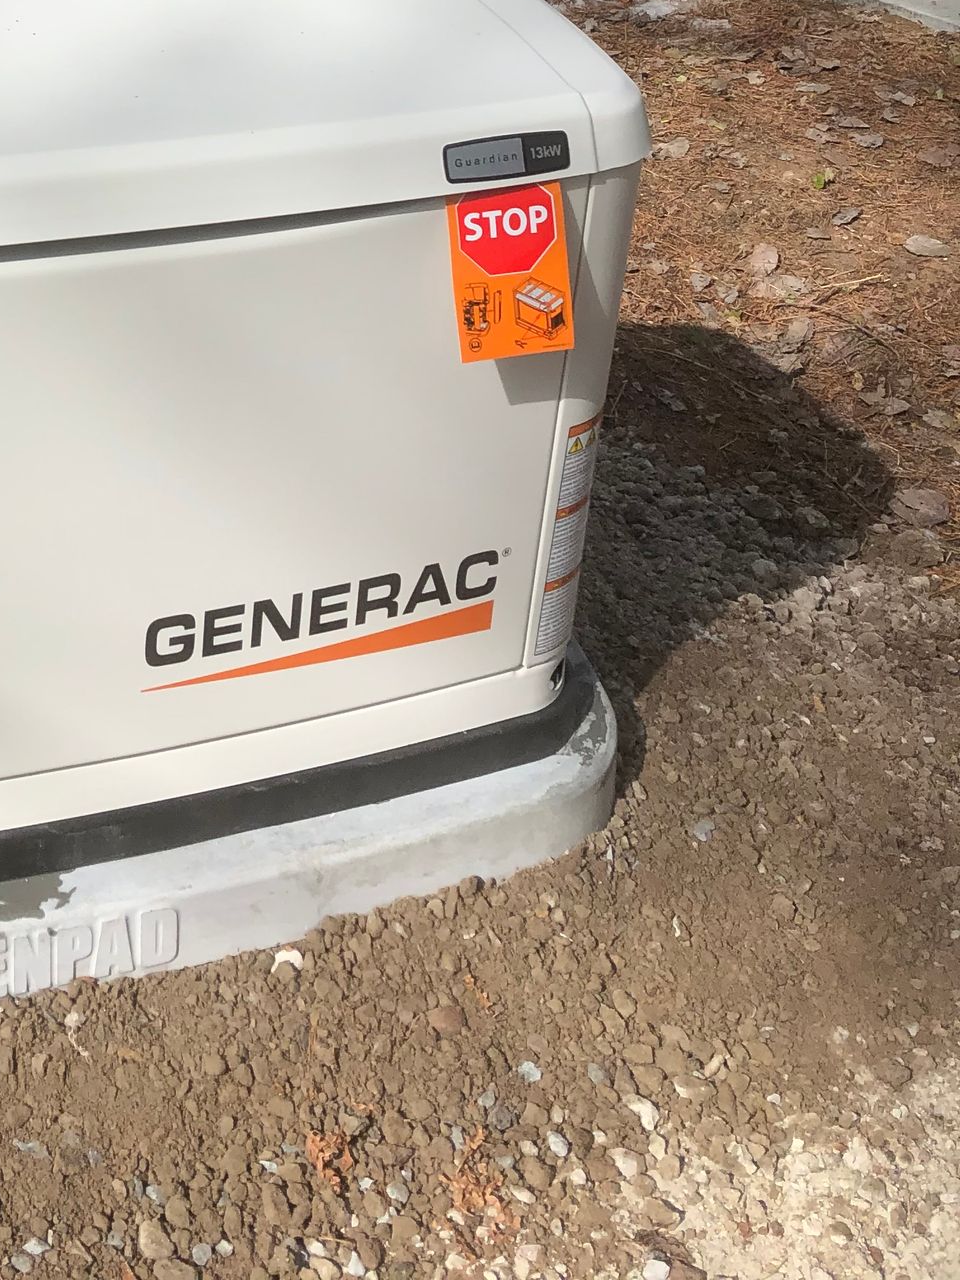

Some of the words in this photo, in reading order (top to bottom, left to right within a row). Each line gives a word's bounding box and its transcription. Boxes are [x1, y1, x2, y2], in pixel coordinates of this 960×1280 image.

[454, 151, 519, 169] Guardian
[529, 143, 562, 160] 13kW
[463, 204, 549, 242] STOP
